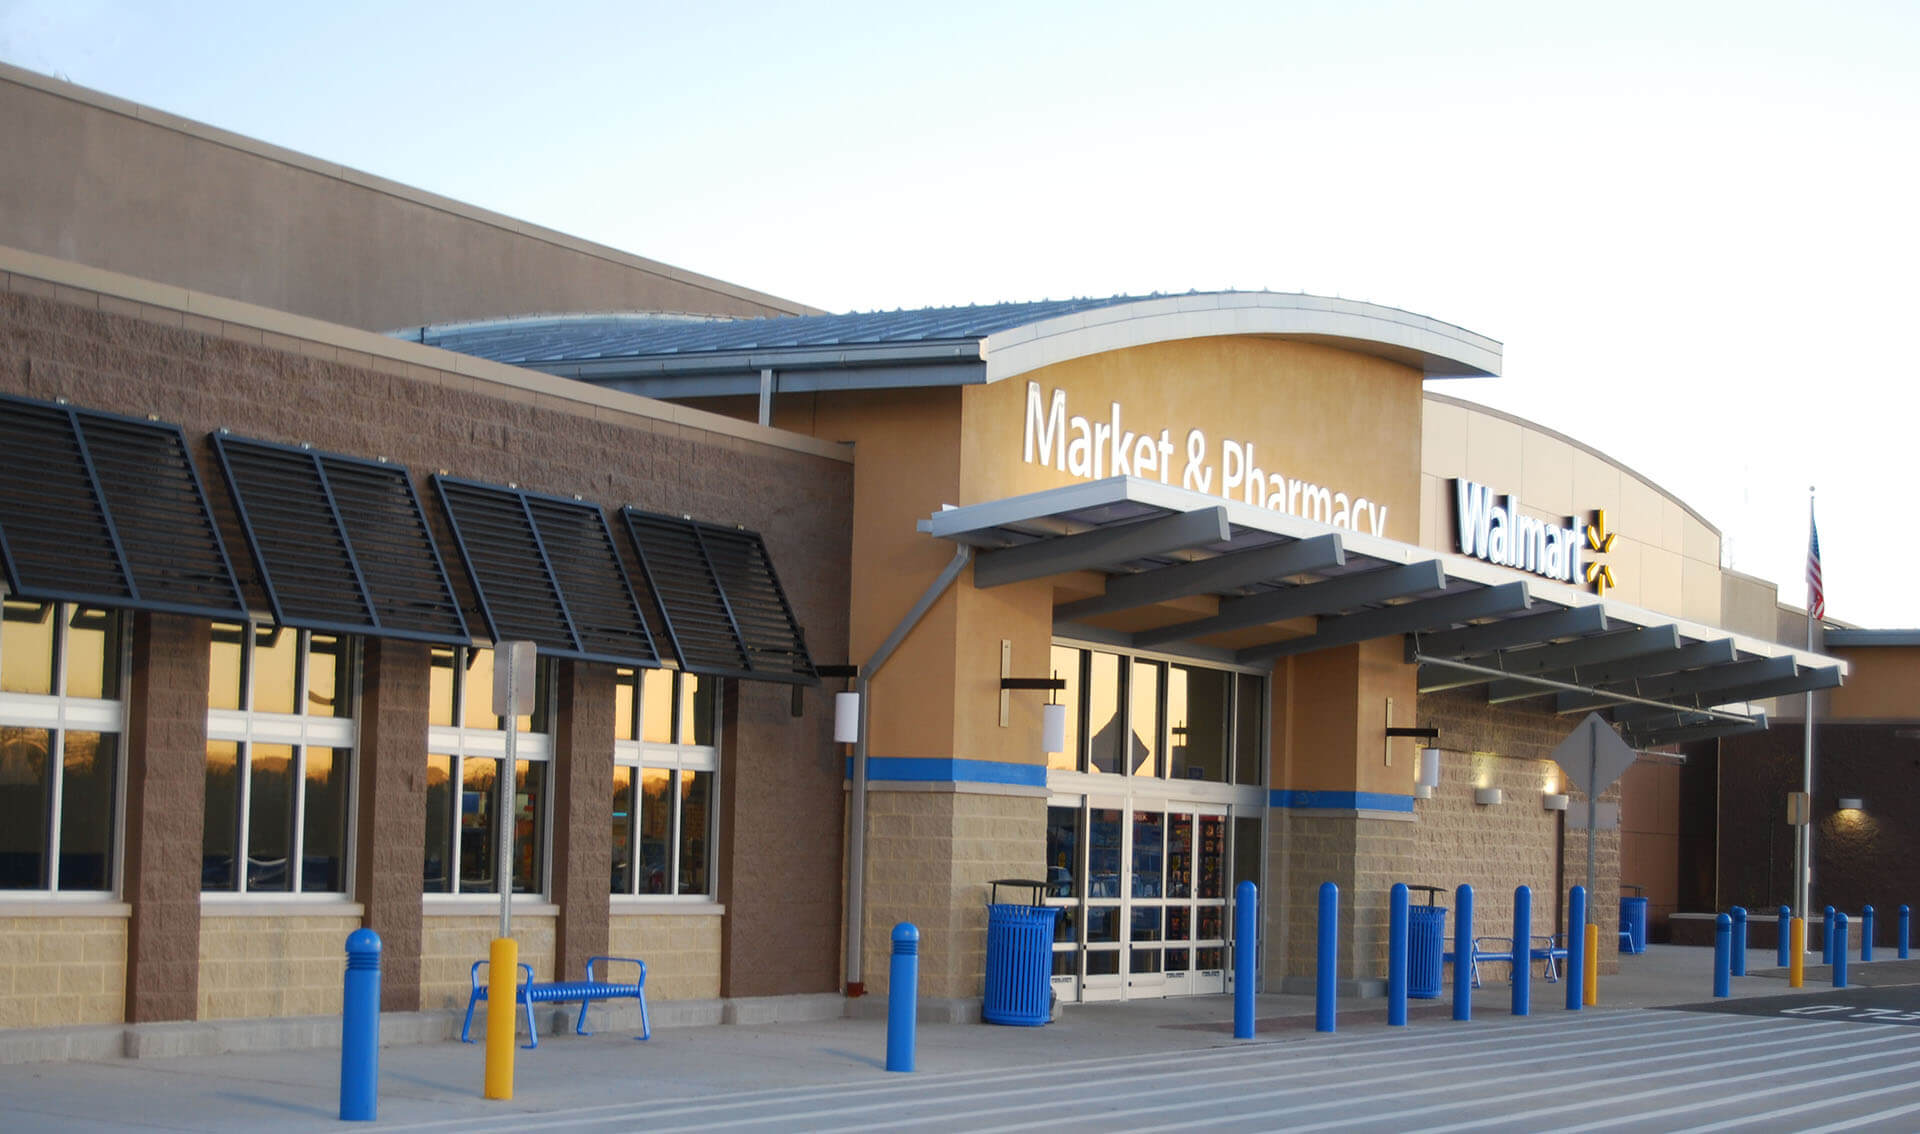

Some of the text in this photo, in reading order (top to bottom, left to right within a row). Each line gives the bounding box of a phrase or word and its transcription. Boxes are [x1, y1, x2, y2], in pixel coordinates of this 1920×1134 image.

[1024, 381, 1174, 484] Market
[1183, 429, 1212, 494] &
[1453, 478, 1585, 585] Walmart
